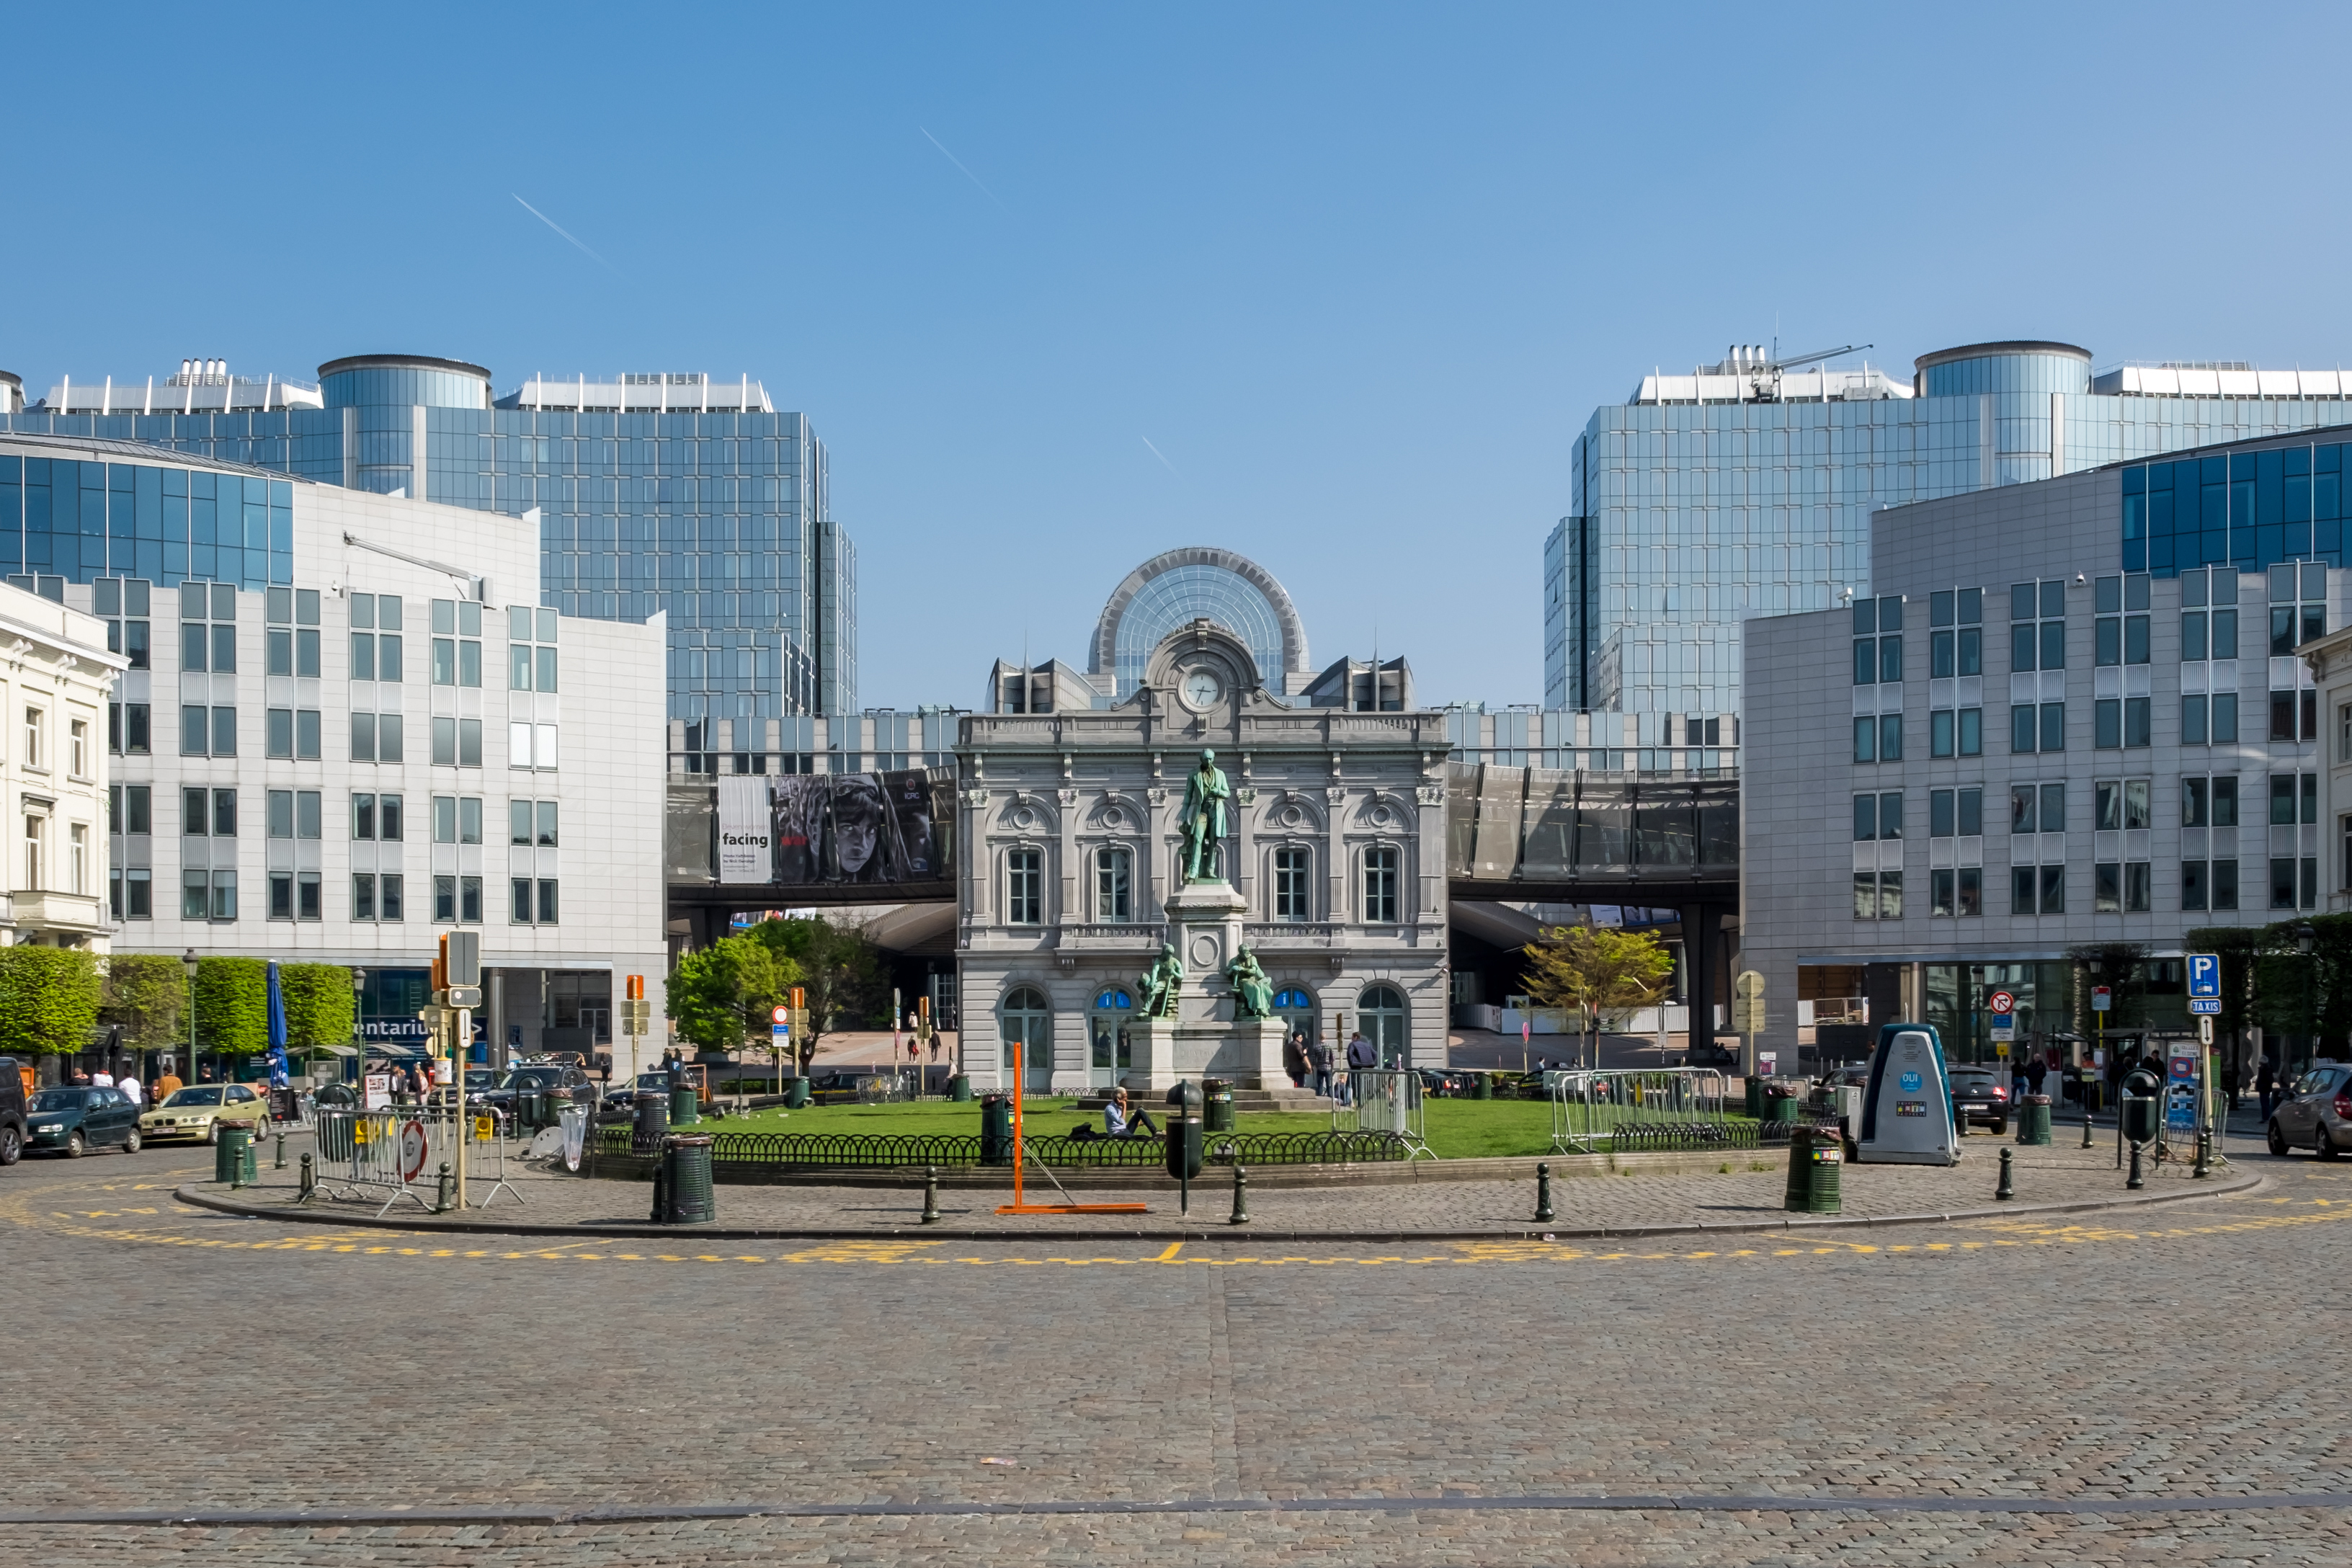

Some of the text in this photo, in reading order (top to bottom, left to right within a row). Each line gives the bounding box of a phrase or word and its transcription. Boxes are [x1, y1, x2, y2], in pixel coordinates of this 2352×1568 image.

[722, 833, 768, 848] facing
[2195, 958, 2212, 979] P
[2193, 1002, 2219, 1012] TAXIS
[353, 1019, 429, 1035] entariu
[673, 1061, 680, 1070] P
[1902, 1073, 1918, 1082] OUI
